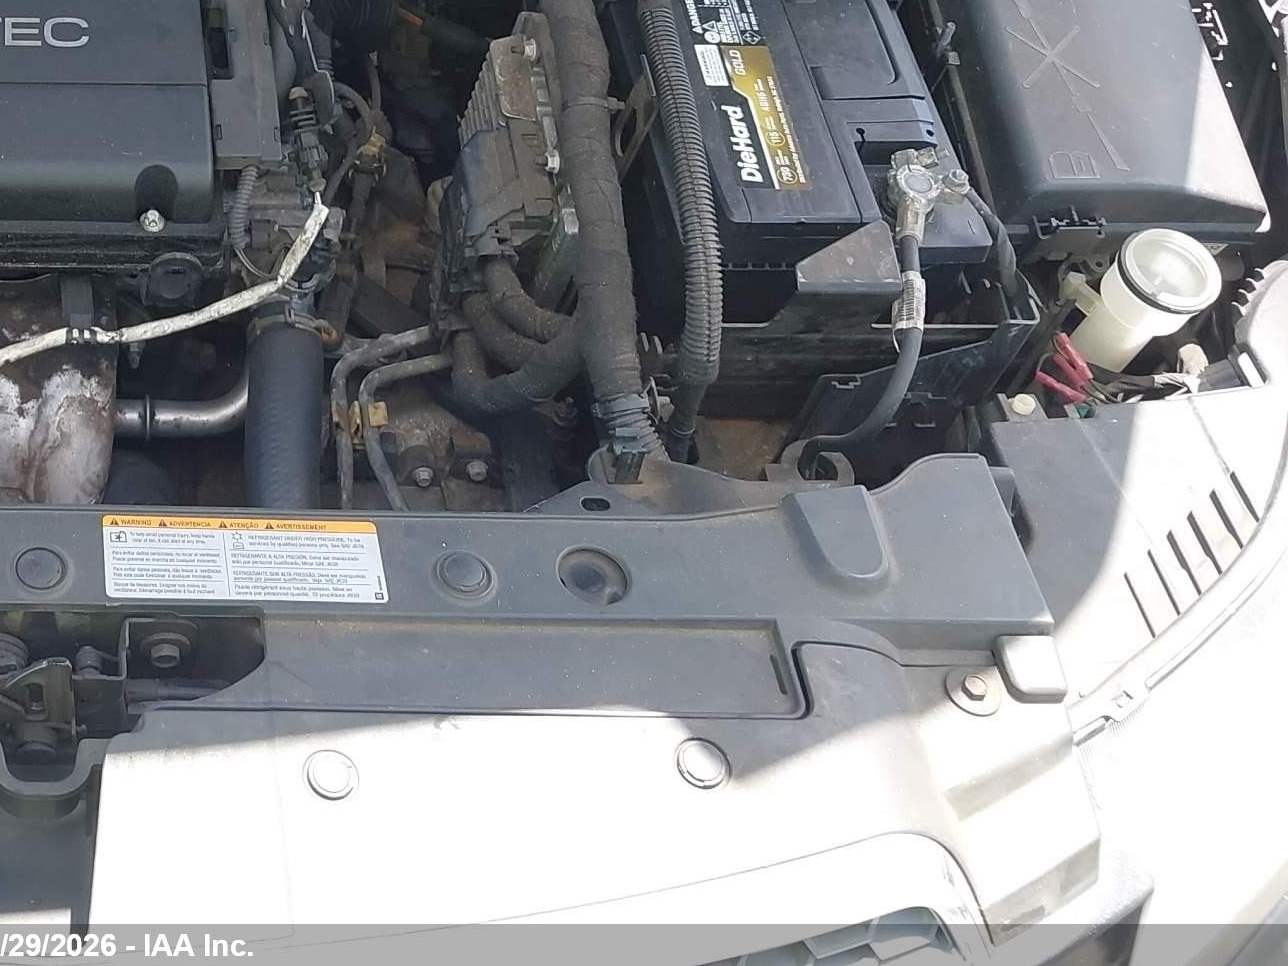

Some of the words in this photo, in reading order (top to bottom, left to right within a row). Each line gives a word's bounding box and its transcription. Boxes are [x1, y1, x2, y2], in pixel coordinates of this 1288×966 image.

[728, 49, 746, 75] GOLD
[720, 105, 764, 182] DieHard
[229, 521, 259, 530] ATENÇÃO
